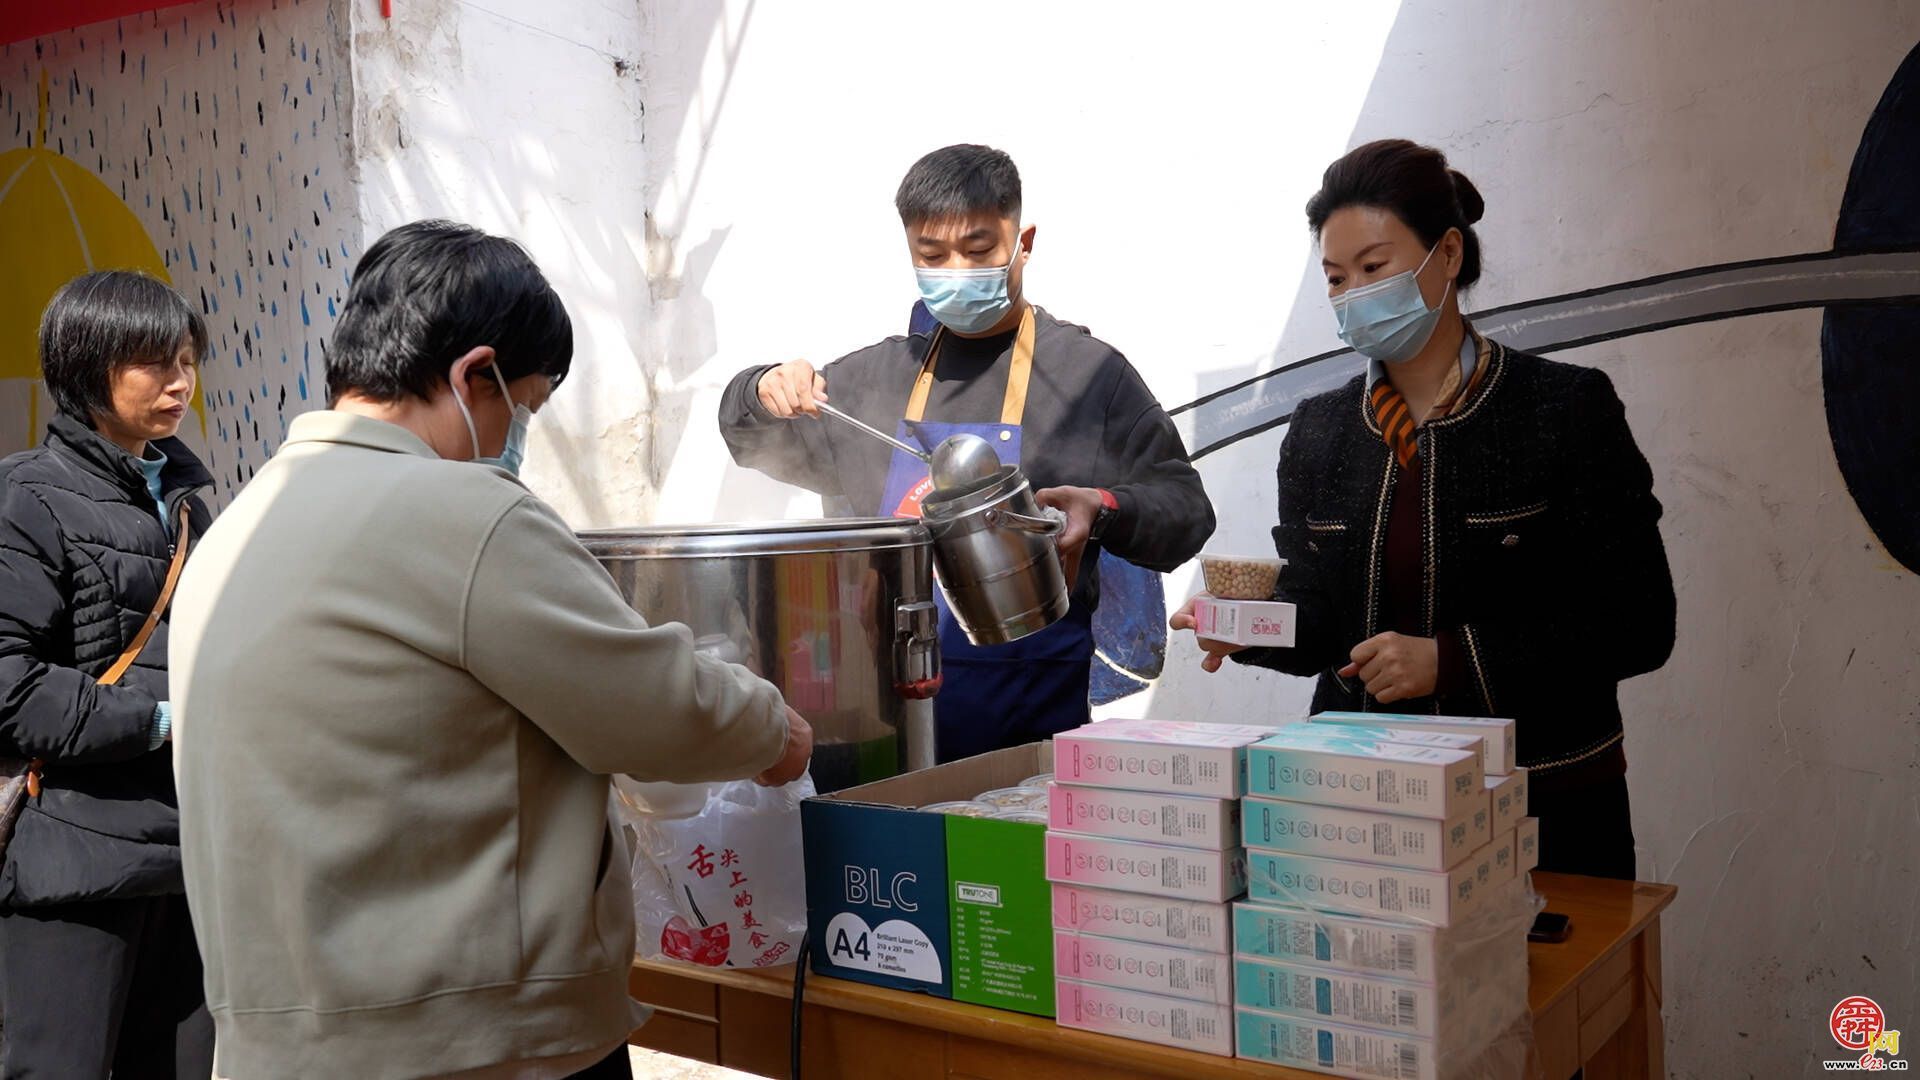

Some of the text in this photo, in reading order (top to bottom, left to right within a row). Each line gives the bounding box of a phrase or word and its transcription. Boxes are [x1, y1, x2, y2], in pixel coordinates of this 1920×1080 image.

[687, 843, 770, 949] 舌尖上的美食
[844, 865, 918, 912] BLC
[832, 928, 871, 961] A4
